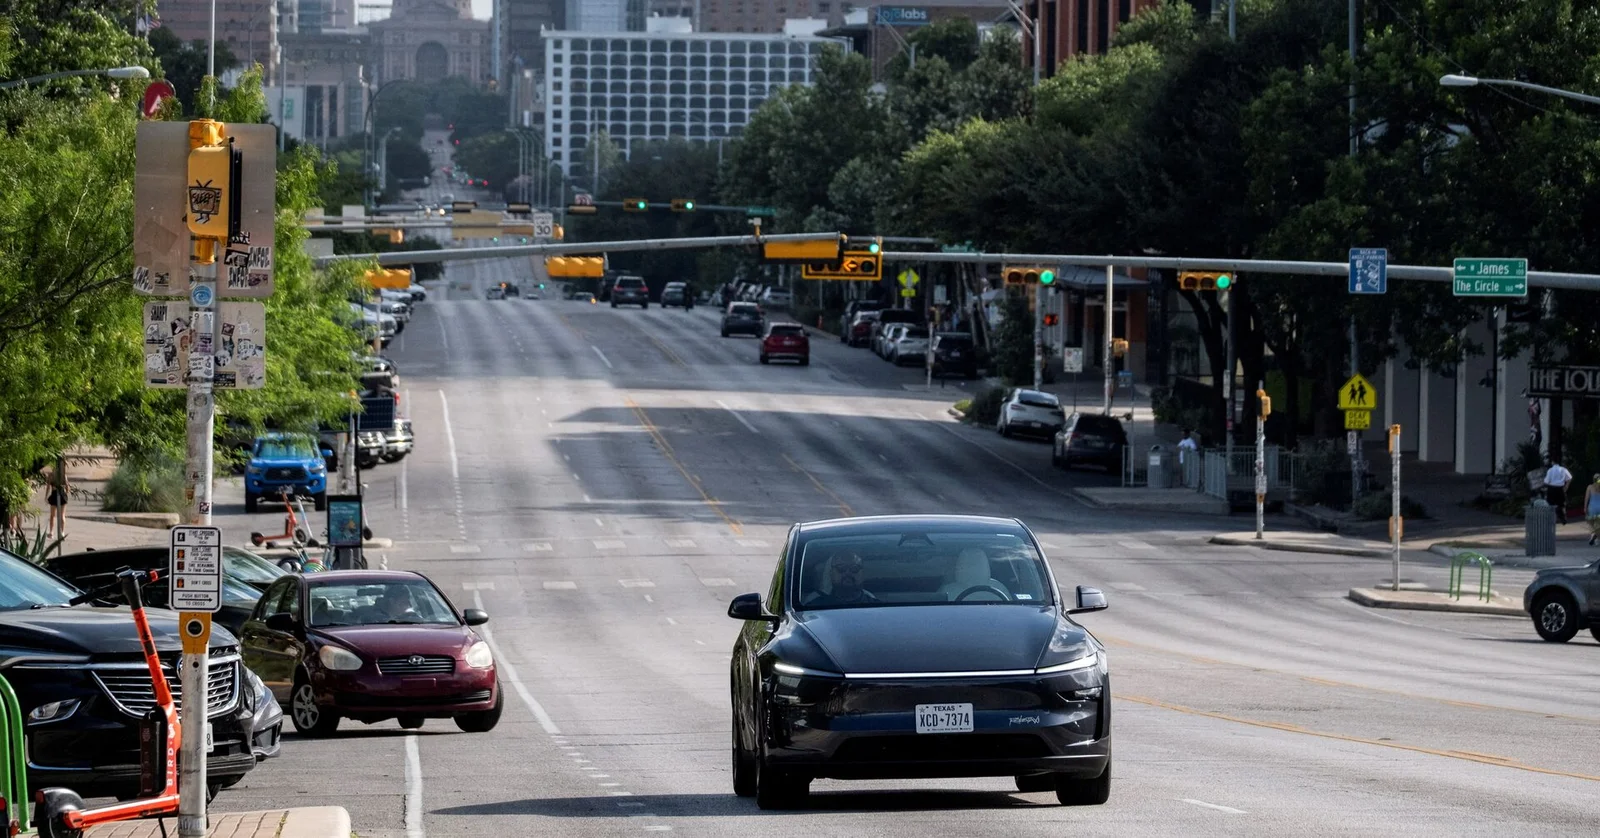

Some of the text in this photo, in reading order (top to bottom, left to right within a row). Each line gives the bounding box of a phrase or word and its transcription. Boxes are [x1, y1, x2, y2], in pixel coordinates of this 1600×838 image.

[536, 225, 551, 235] 30
[1477, 261, 1510, 276] James
[1456, 280, 1471, 292] The
[1474, 280, 1500, 292] Circle
[1532, 369, 1562, 390] THE
